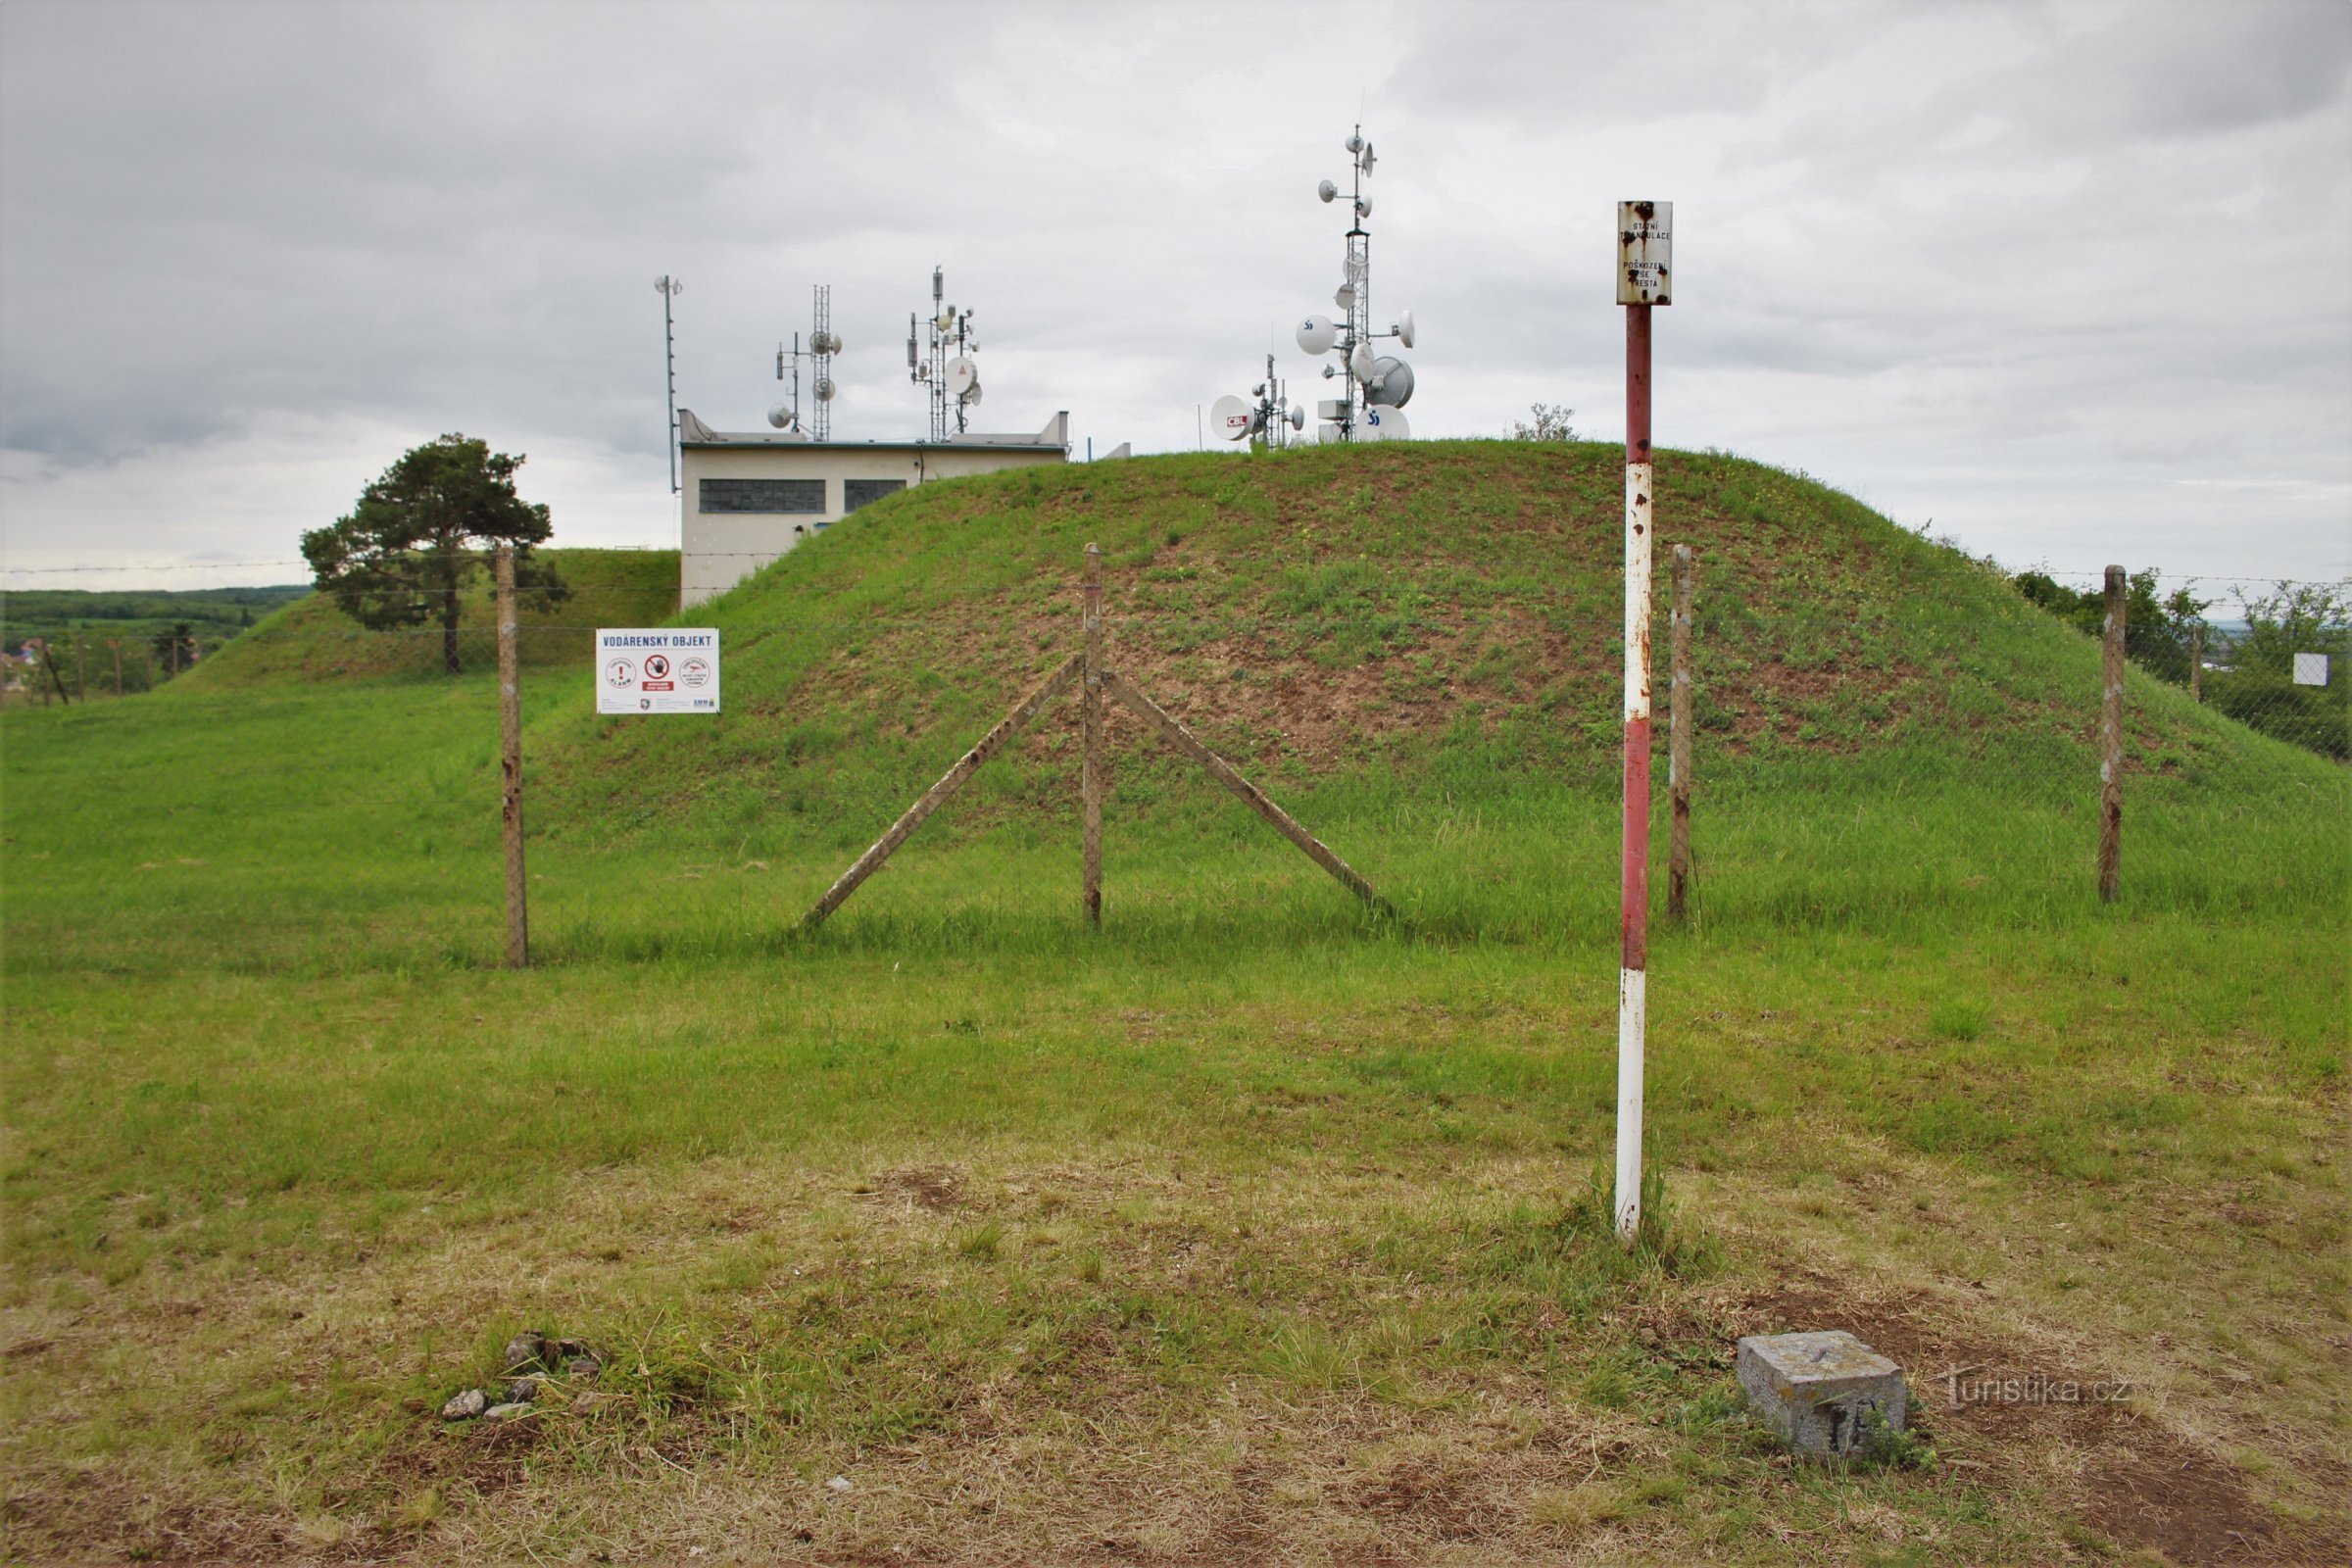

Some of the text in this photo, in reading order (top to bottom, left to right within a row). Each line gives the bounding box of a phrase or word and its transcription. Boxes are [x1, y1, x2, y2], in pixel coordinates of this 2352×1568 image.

[1620, 231, 1670, 240] TNULACE
[1630, 278, 1658, 287] RESTÁ
[1228, 416, 1246, 425] CBL
[603, 634, 712, 647] VODÁRENSKÝ OBJEKT
[610, 678, 632, 687] ALARM
